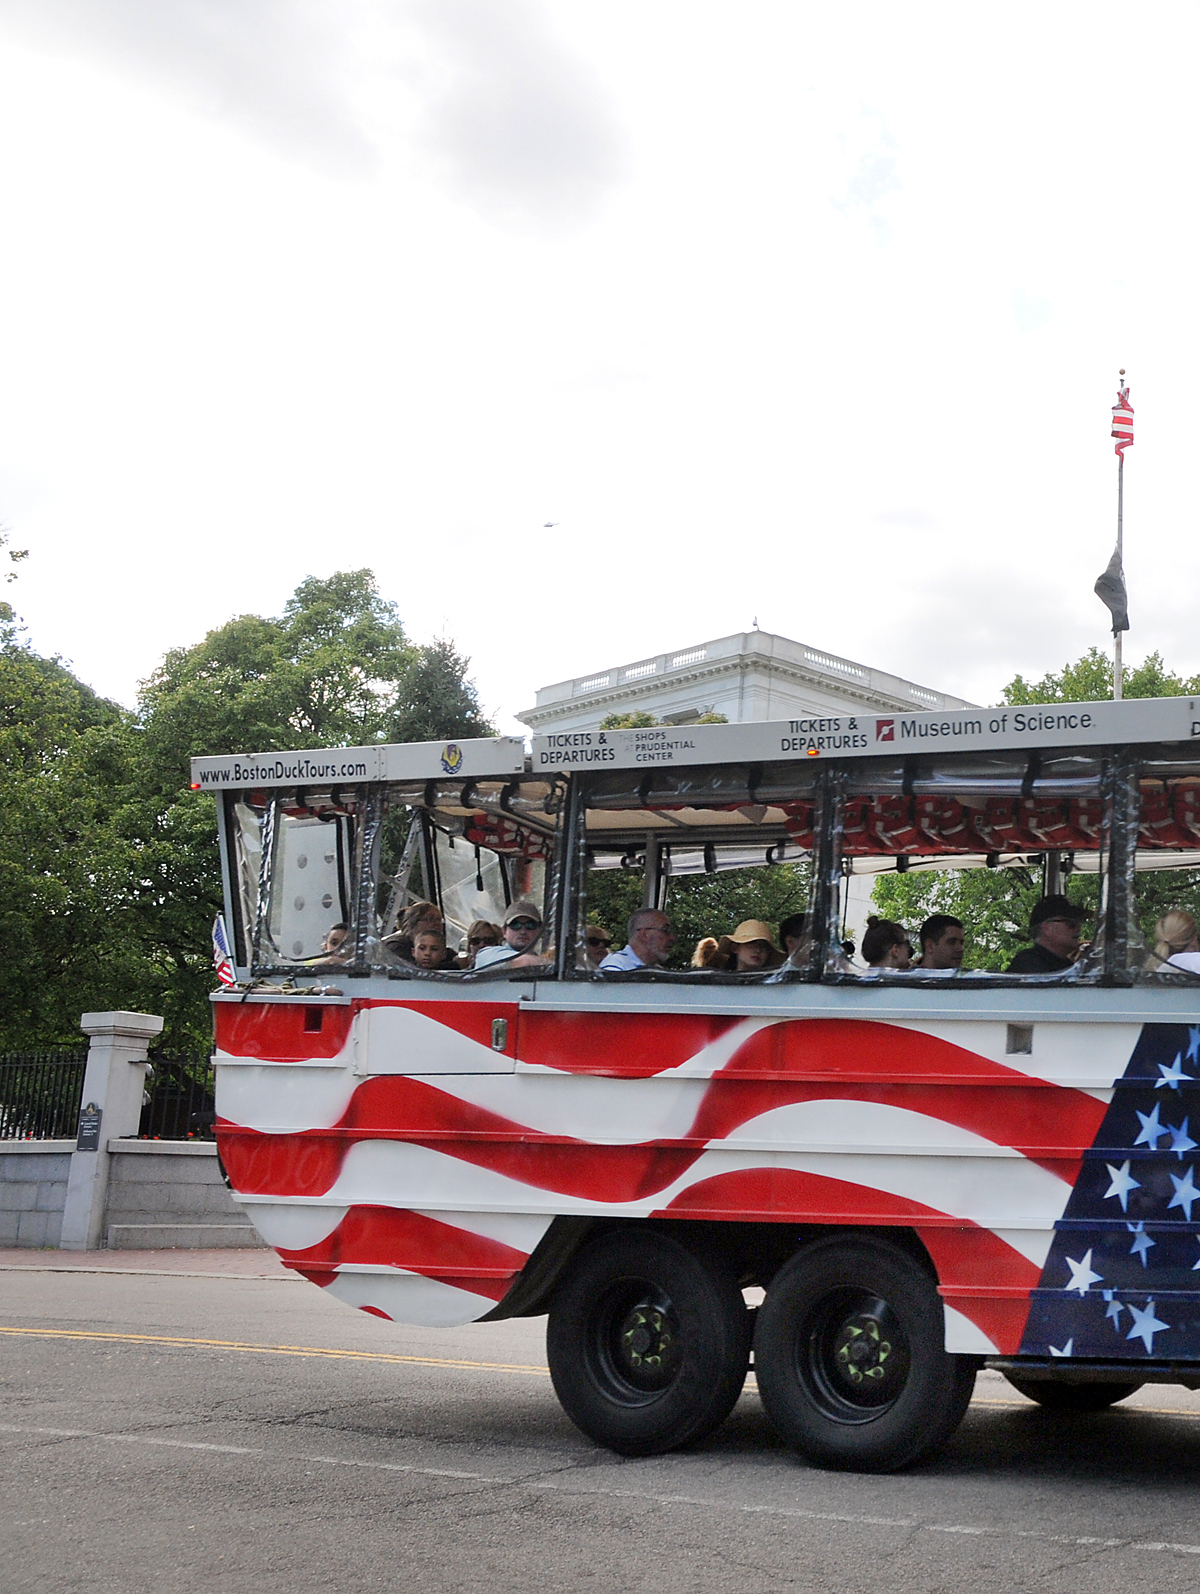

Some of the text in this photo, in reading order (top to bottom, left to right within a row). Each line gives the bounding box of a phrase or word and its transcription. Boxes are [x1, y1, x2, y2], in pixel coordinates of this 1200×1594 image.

[788, 716, 858, 733] TICKETS &
[901, 718, 982, 738] Museum
[990, 714, 1007, 733] of
[547, 732, 607, 748] TICKETS &
[635, 732, 666, 741] SHOPS
[781, 734, 867, 751] DEPARTURES
[635, 741, 695, 752] PRUDENTIAL
[541, 748, 615, 764] DEPARTURES
[636, 752, 673, 761] CENTER
[200, 760, 367, 783] www.BostonDuckTours.com
